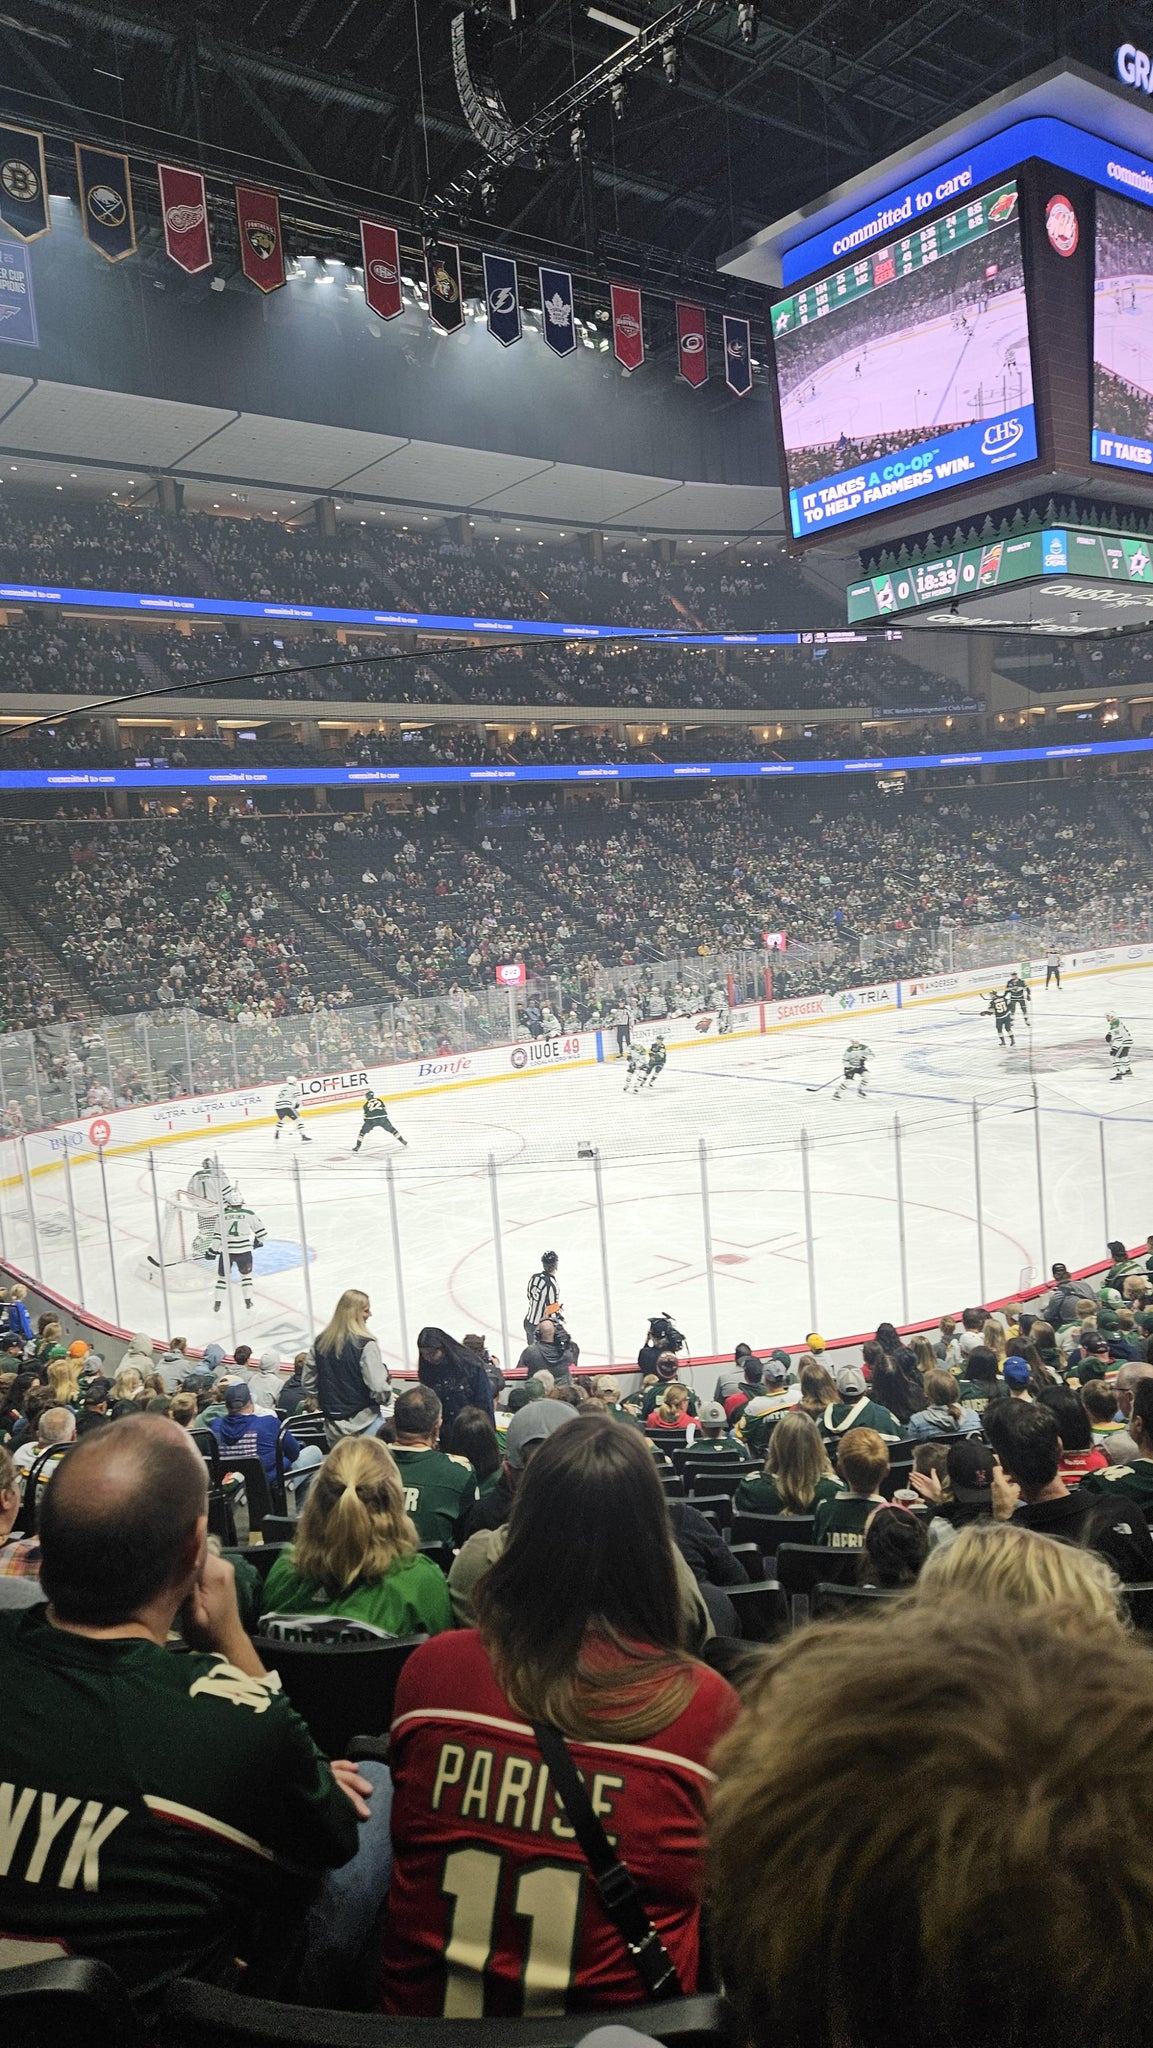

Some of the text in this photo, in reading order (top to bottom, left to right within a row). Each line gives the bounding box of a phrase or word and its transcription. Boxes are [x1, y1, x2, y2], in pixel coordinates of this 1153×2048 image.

[833, 171, 971, 255] committed to care
[9, 269, 25, 281] CUP
[984, 418, 1019, 445] CHS
[1100, 439, 1153, 465] IT TAKES
[803, 493, 817, 510] IT
[818, 476, 867, 503] TAKES
[868, 471, 881, 487] A
[804, 507, 824, 523] TO
[825, 494, 862, 517] HELP
[863, 469, 934, 504] FARMERS
[934, 455, 975, 479] WIN.
[917, 567, 925, 576] 2
[1111, 558, 1119, 569] 2
[916, 568, 957, 593] 18:33
[962, 564, 975, 583] 0
[898, 581, 910, 600] 0
[47, 774, 89, 783] committed
[926, 977, 958, 990] ANDERSEN
[858, 988, 890, 1004] TRIA
[777, 1000, 824, 1020] SEATGEEK
[995, 1001, 1008, 1013] 97
[530, 1038, 580, 1061] IUOE 49
[418, 1057, 472, 1077] Bonfe
[301, 1073, 369, 1095] LOFFLER
[153, 1095, 262, 1121] ULTRA ULTRA ULTRA
[367, 1099, 383, 1111] 22
[201, 1181, 207, 1199] 1
[228, 1220, 239, 1236] 4
[441, 1848, 582, 2019] 11
